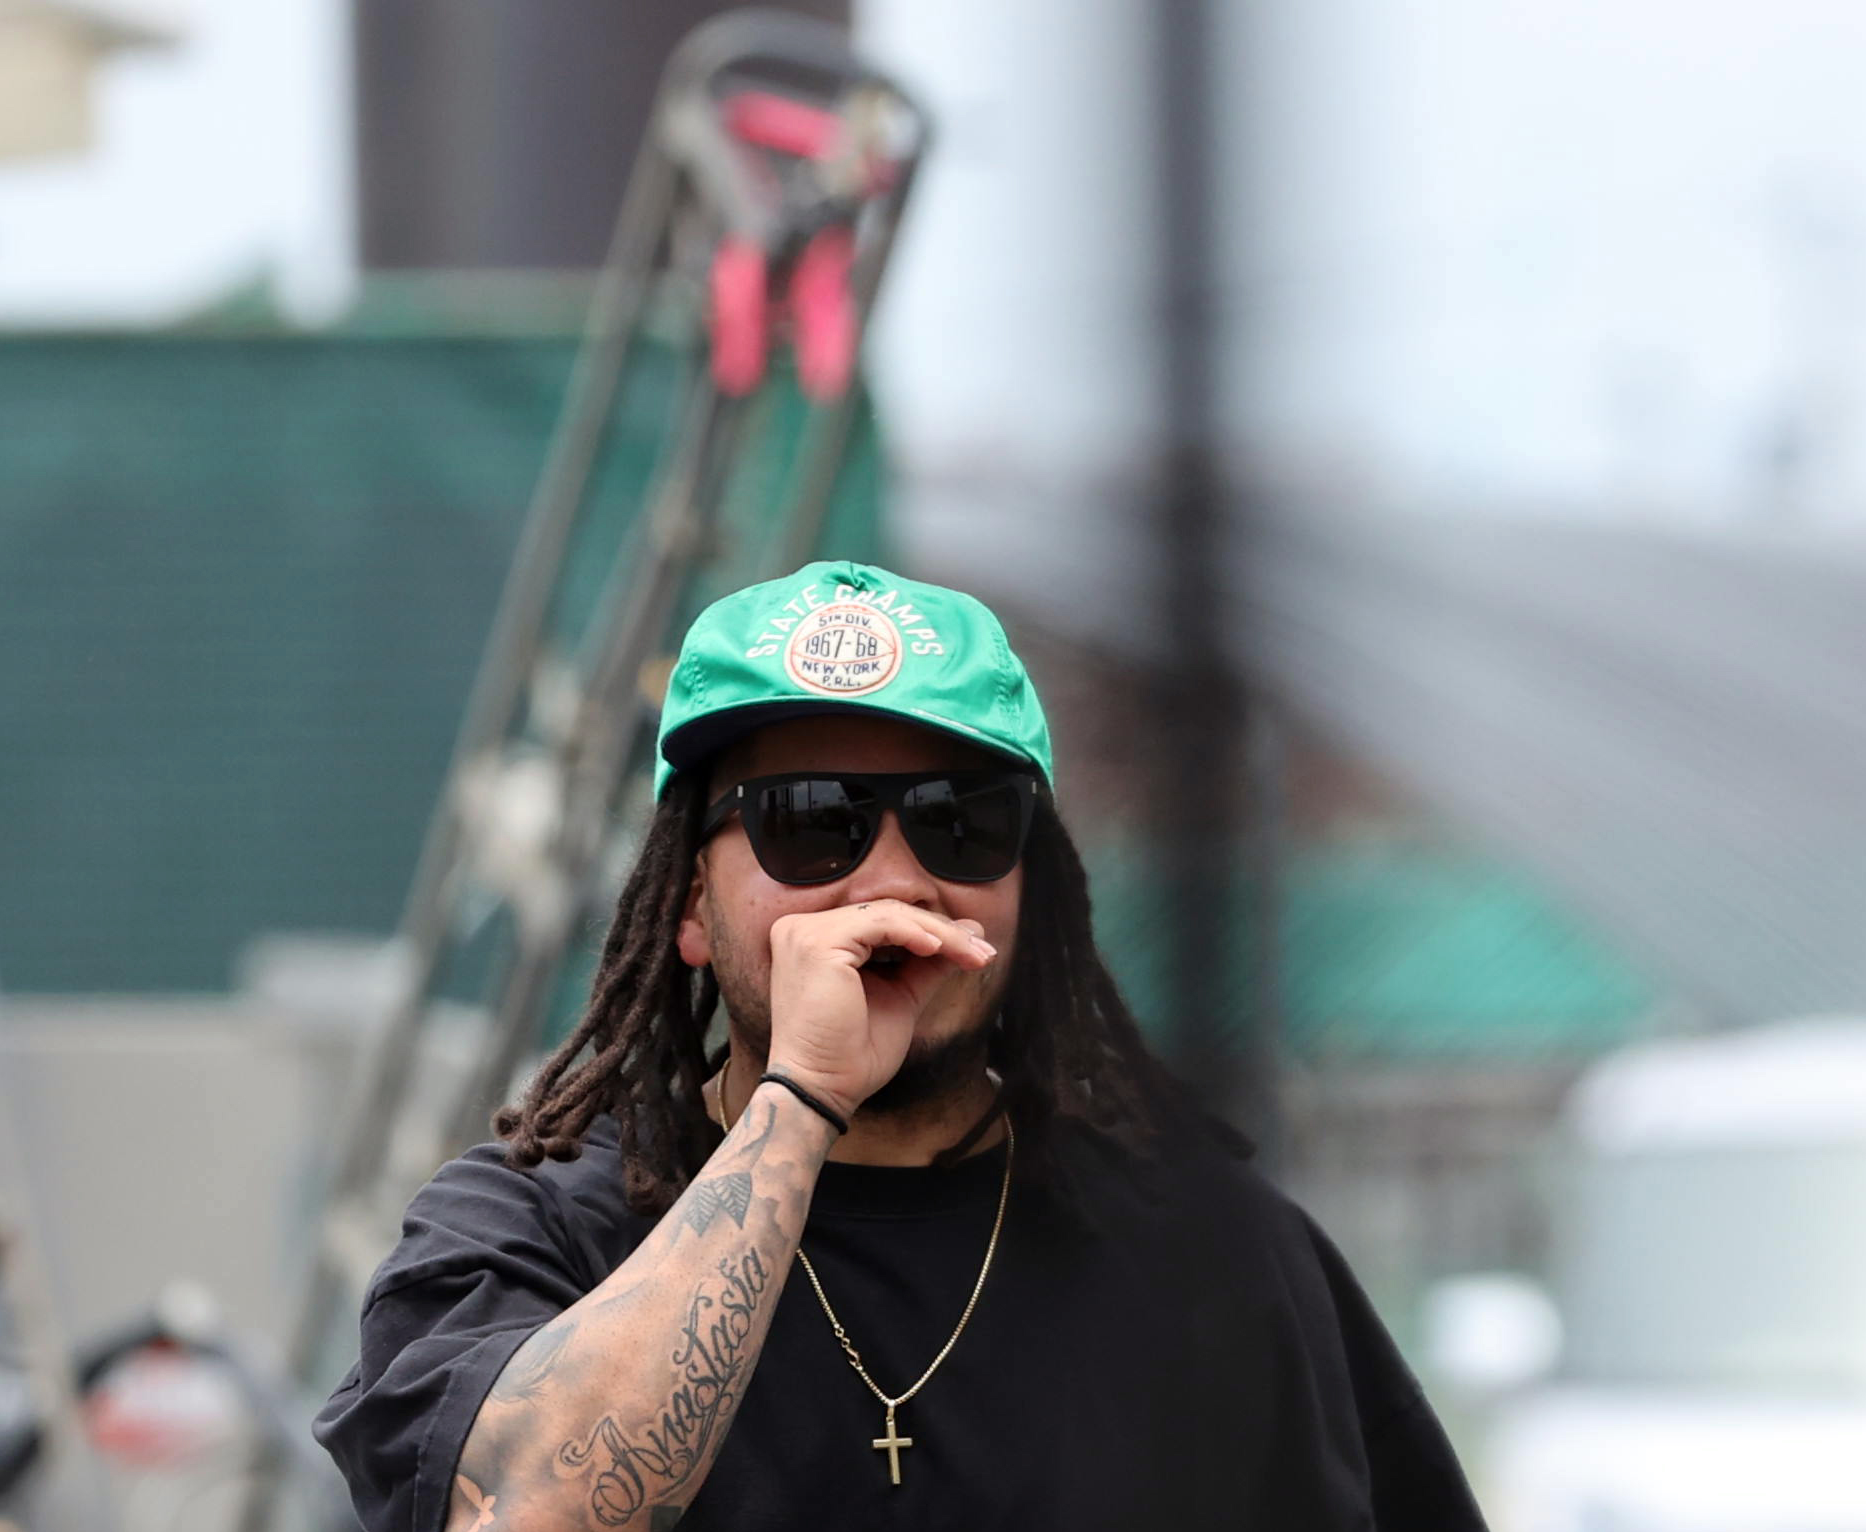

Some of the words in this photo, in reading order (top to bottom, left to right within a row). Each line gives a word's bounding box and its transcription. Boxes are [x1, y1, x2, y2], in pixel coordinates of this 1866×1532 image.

[745, 584, 825, 659] STATE
[834, 584, 945, 656] CHAMPS
[845, 613, 873, 629] DIV.
[802, 661, 836, 675] NEW
[843, 661, 881, 676] YORK
